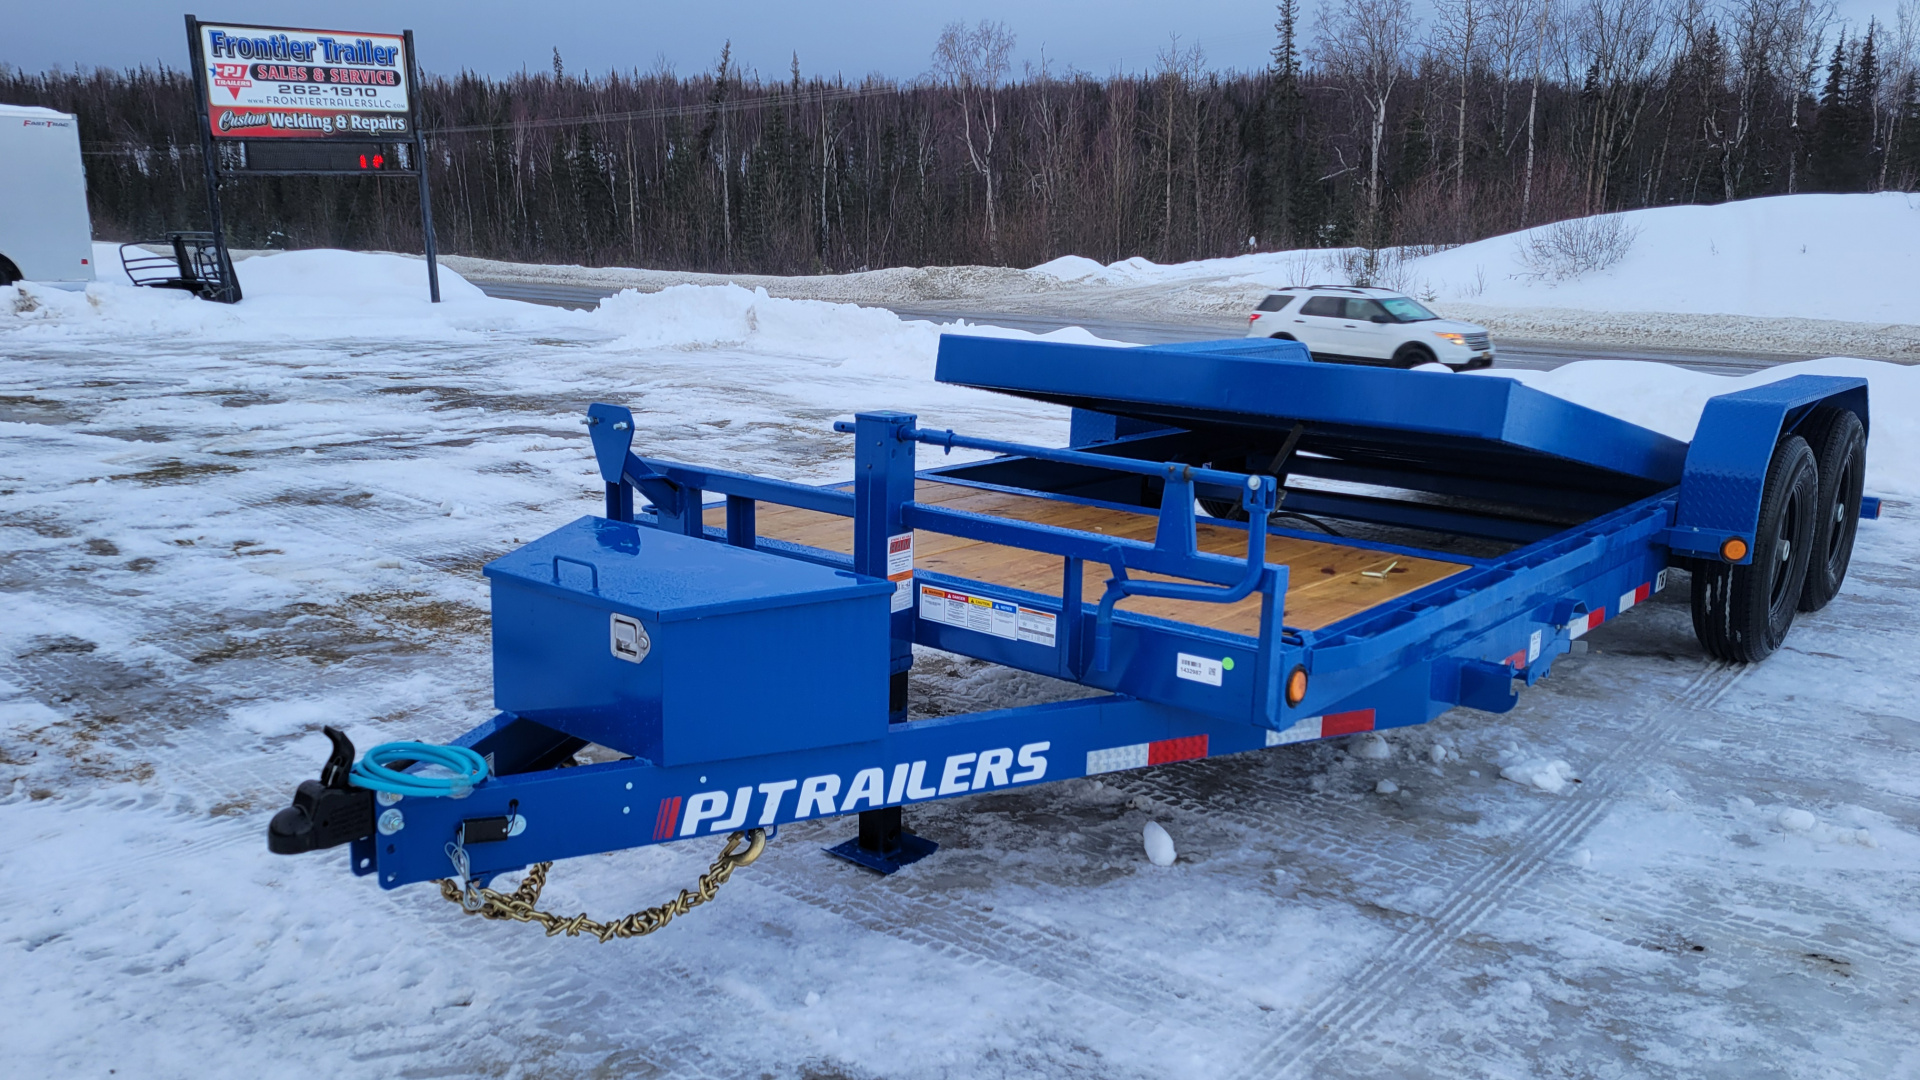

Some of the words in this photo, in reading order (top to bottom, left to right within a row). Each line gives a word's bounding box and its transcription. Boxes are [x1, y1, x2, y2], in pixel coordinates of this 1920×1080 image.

[208, 30, 316, 62] Frontier
[316, 36, 398, 66] Trailer
[223, 65, 243, 77] PJ
[257, 64, 307, 81] SALES
[312, 67, 325, 82] &
[330, 68, 395, 85] SERVICE
[216, 79, 251, 87] TRAILERS
[278, 84, 377, 97] 262-1910
[219, 110, 267, 131] Custom
[269, 112, 334, 133] Welding
[336, 114, 348, 129] &
[351, 115, 406, 133] Repairs
